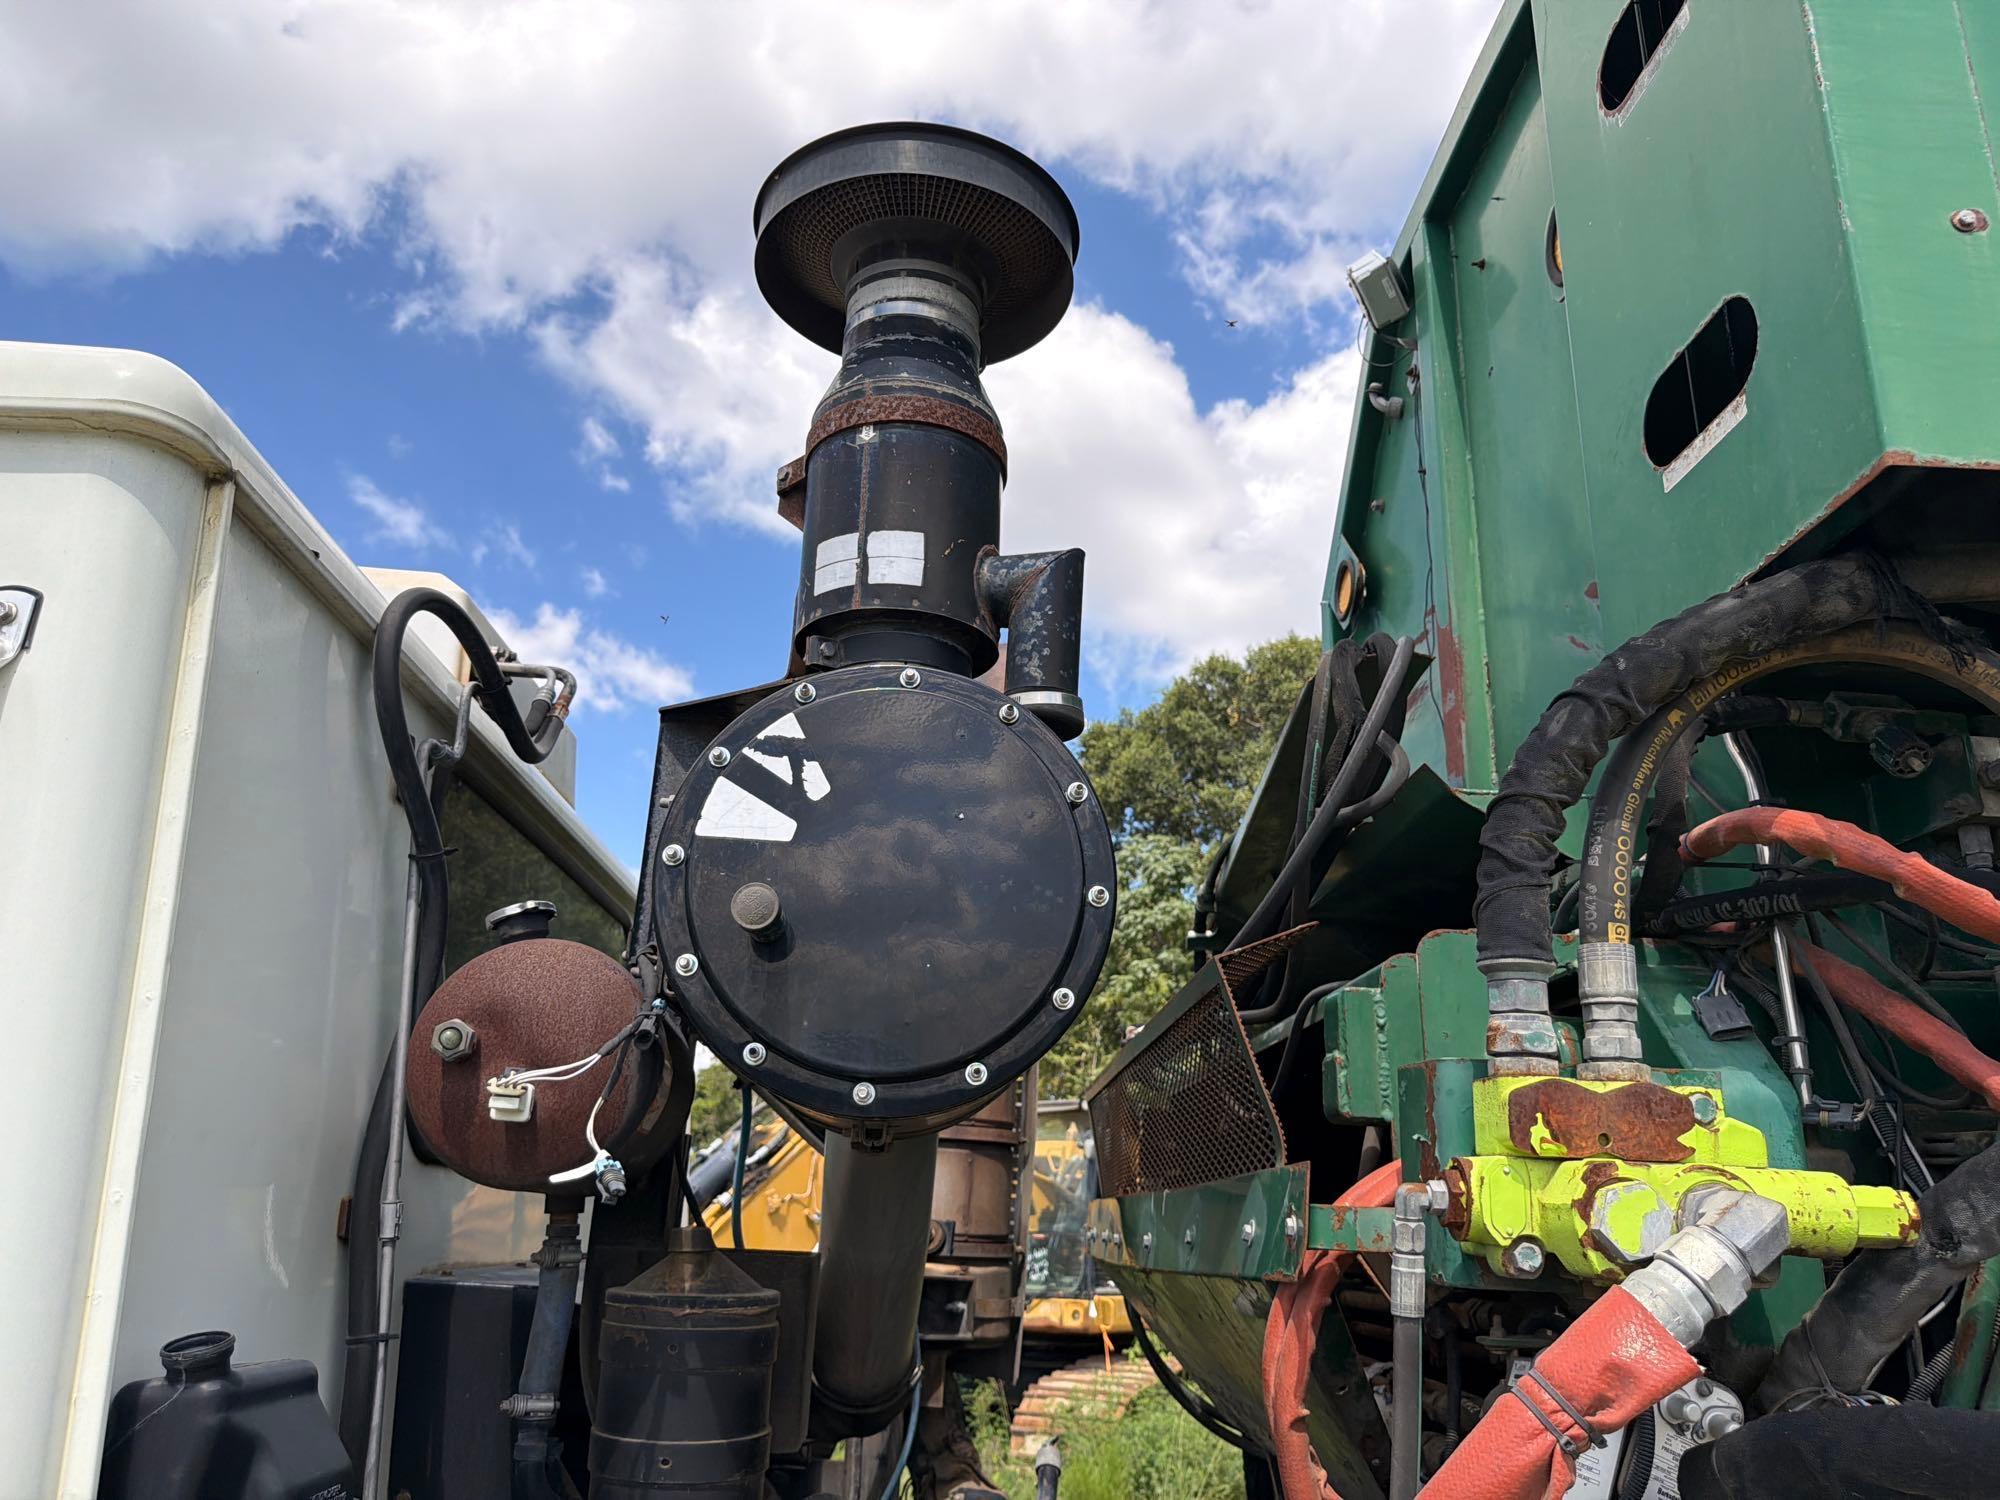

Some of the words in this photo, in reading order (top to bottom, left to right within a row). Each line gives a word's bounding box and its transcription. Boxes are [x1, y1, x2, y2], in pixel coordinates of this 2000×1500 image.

[1631, 726, 1674, 791] MatchMate
[1619, 792, 1640, 832] Global
[1614, 898, 1626, 920] 4S
